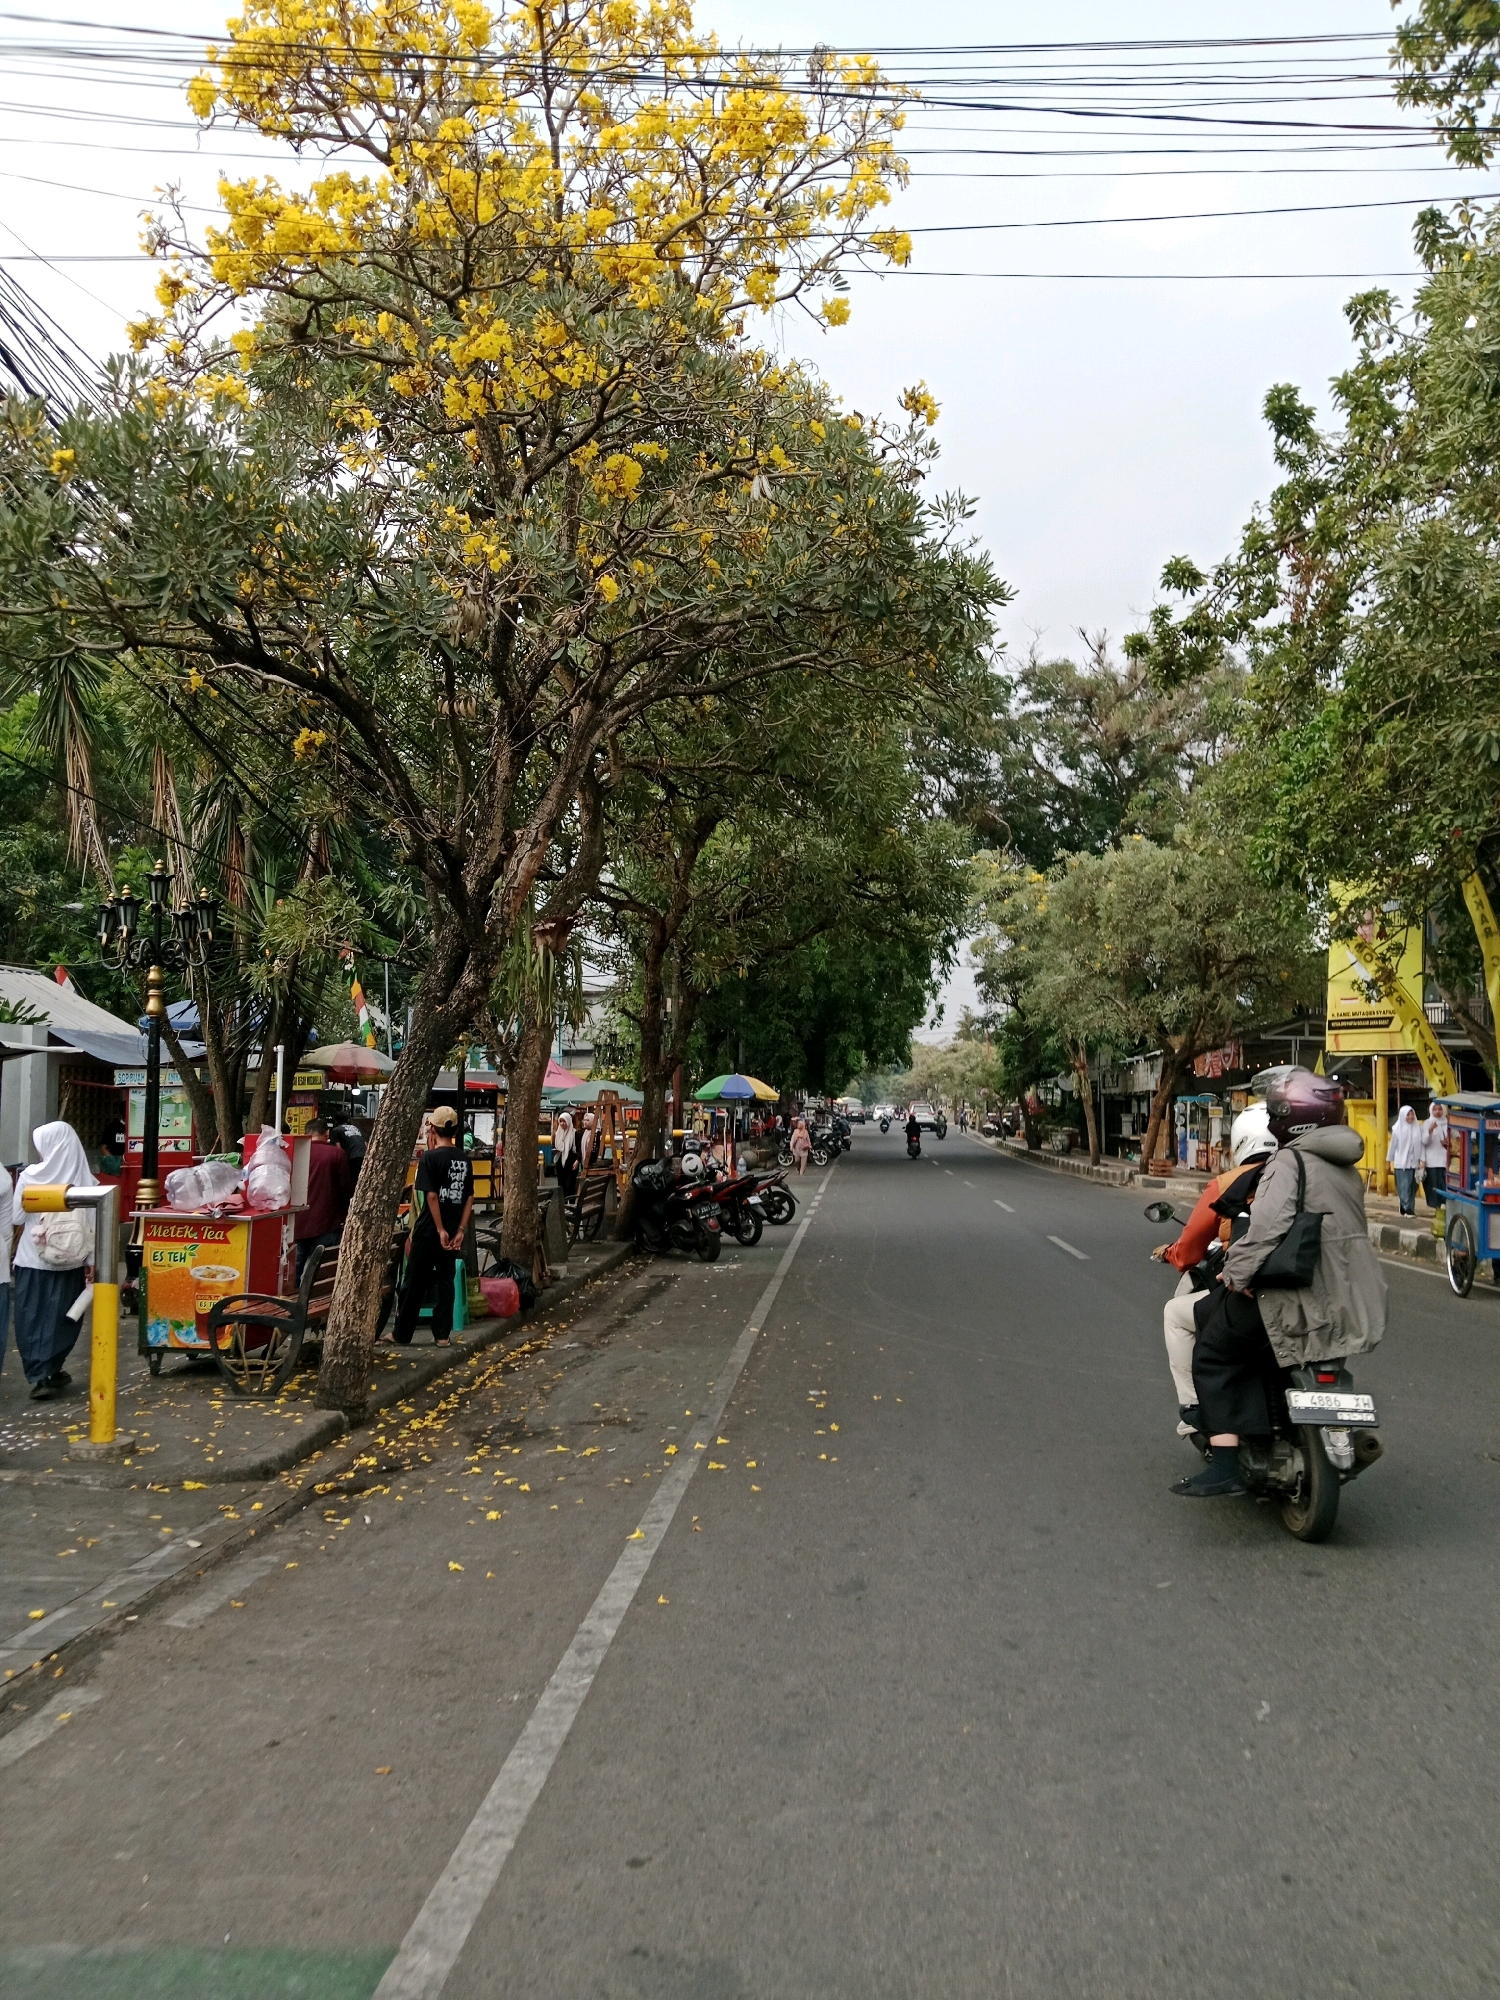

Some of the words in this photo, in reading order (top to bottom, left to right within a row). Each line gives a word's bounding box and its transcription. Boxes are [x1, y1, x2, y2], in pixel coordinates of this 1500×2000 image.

[201, 1225, 225, 1240] Tea
[152, 1250, 164, 1262] ES
[167, 1250, 187, 1263] TEH
[1310, 1395, 1341, 1407] 4886
